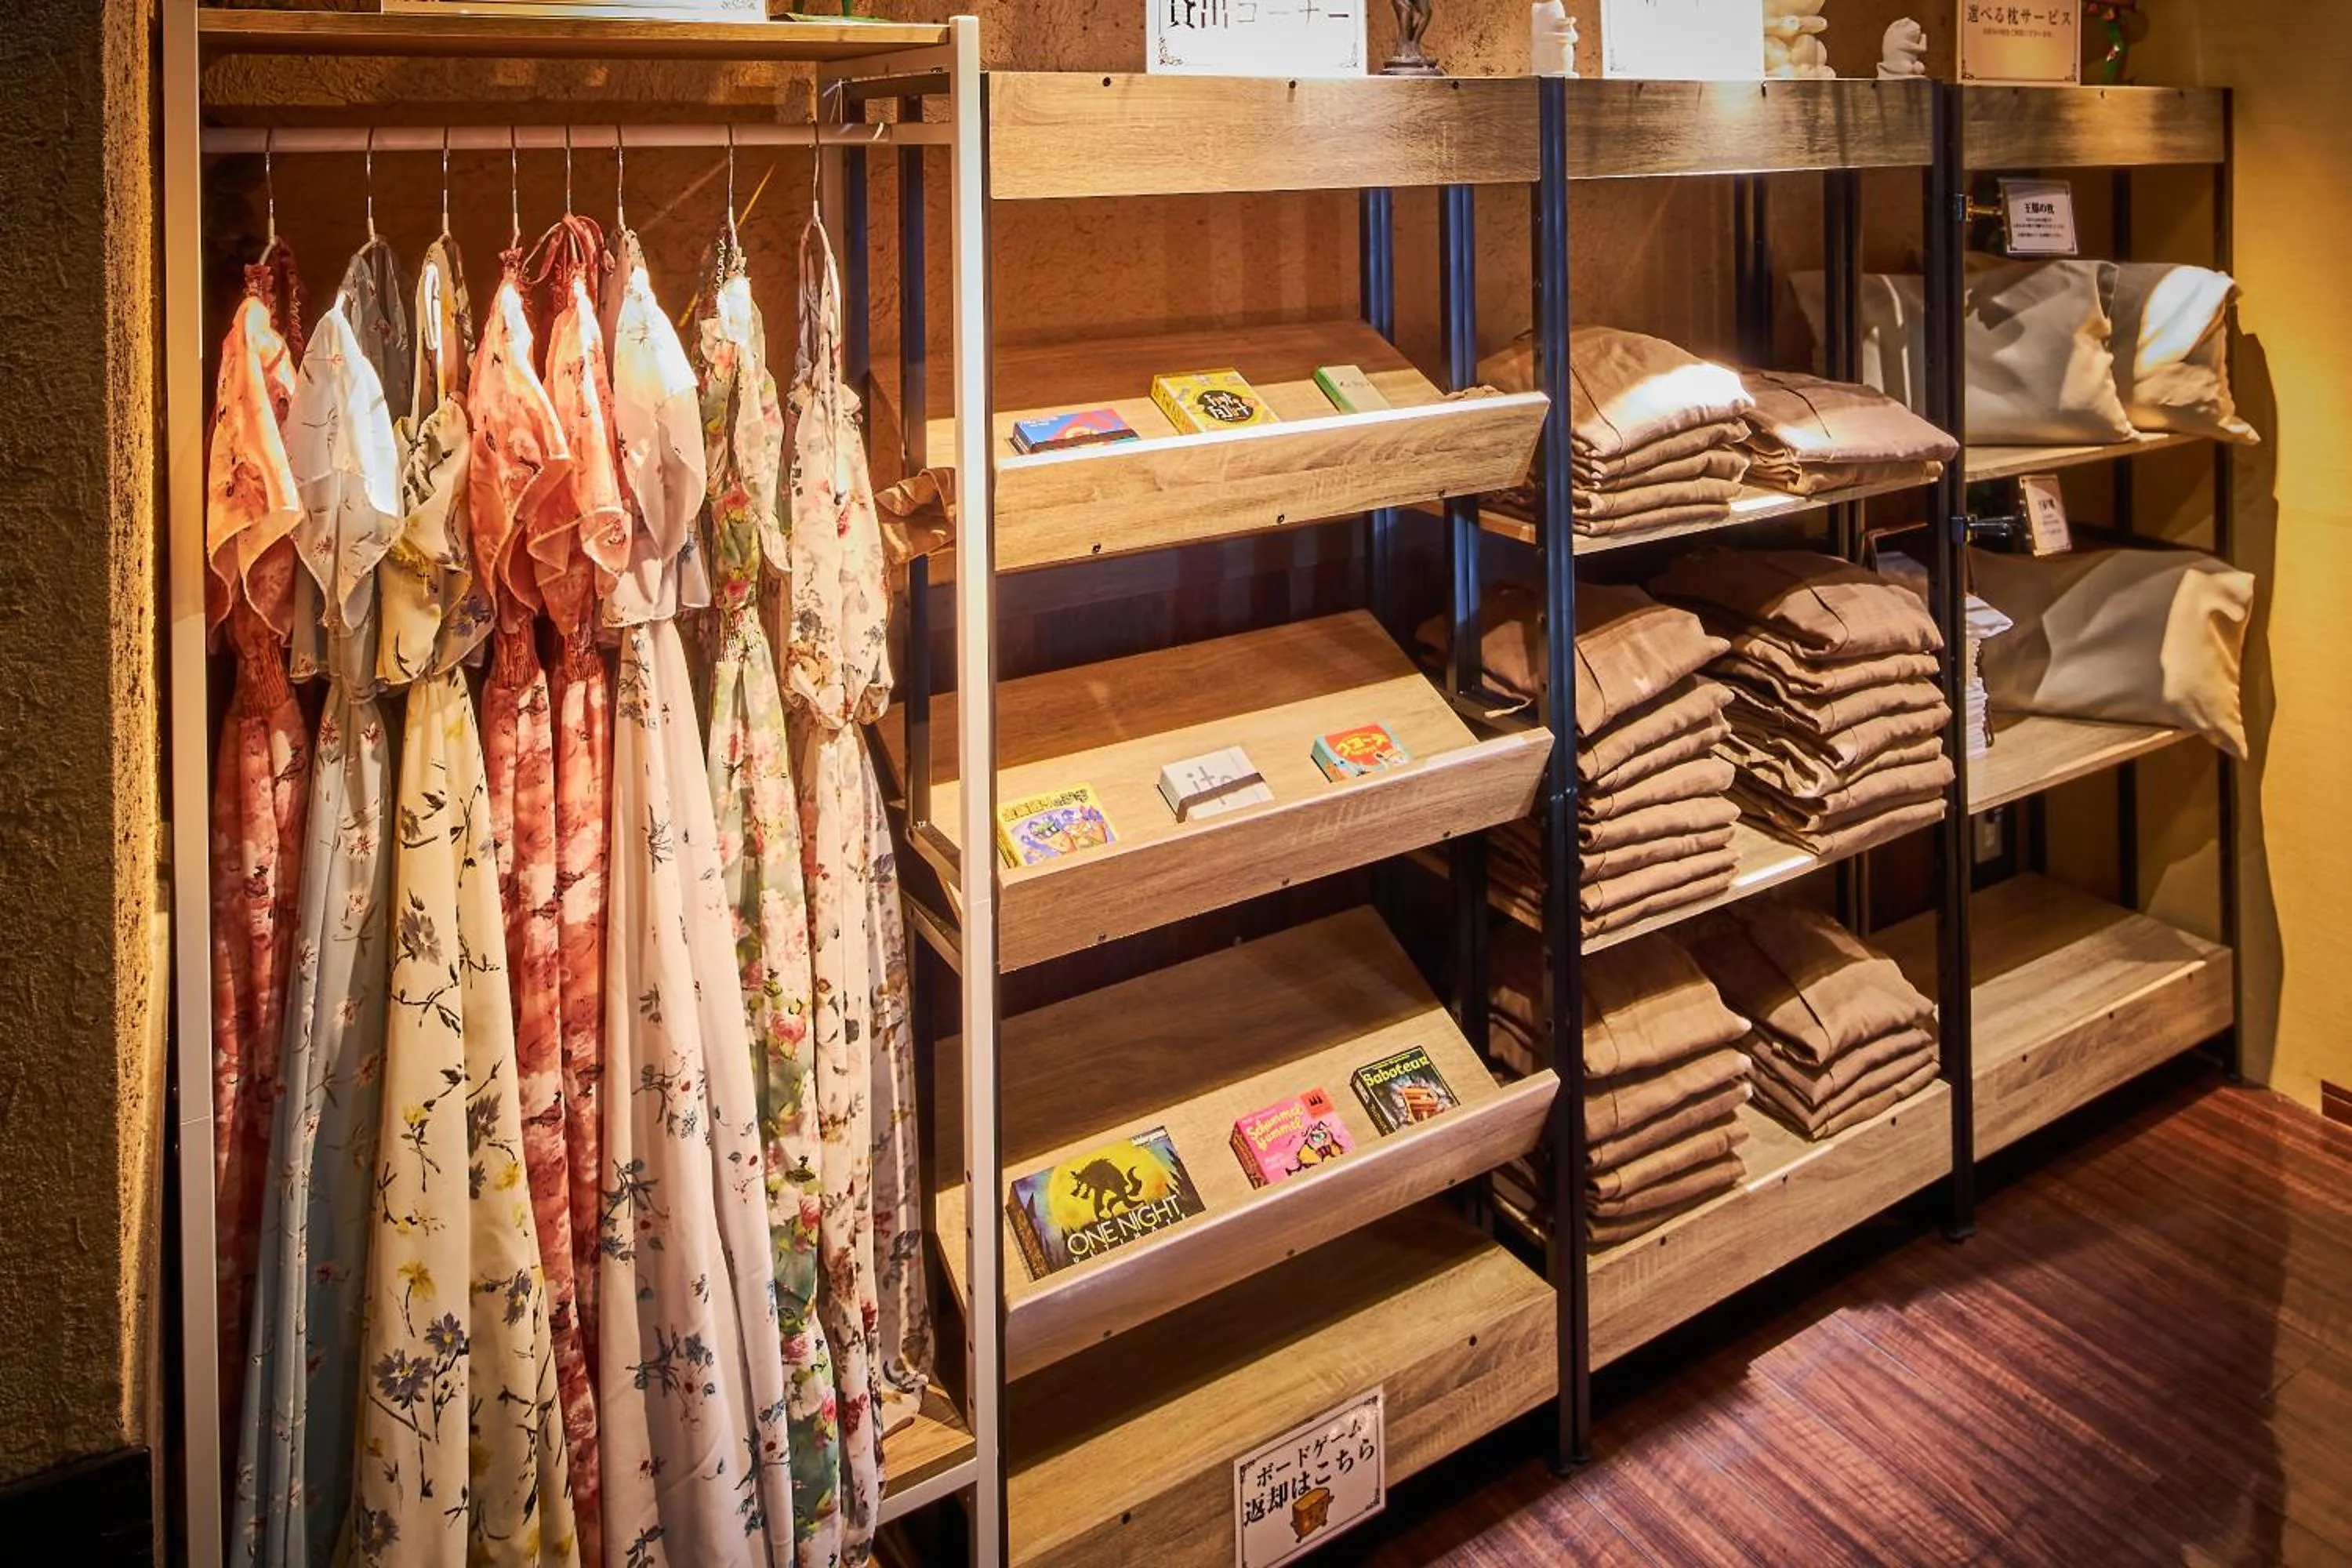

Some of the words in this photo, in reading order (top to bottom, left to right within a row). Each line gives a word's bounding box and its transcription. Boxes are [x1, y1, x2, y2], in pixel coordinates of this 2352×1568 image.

[1967, 5, 2071, 26] 選べる枕サービス
[1363, 1056, 1430, 1088] Saboteur
[1067, 1220, 1119, 1254] ONE
[1116, 1194, 1181, 1236] NIGHT
[1243, 1439, 1374, 1527] 返却はこちら
[1256, 1419, 1362, 1487] ボードゲーム
